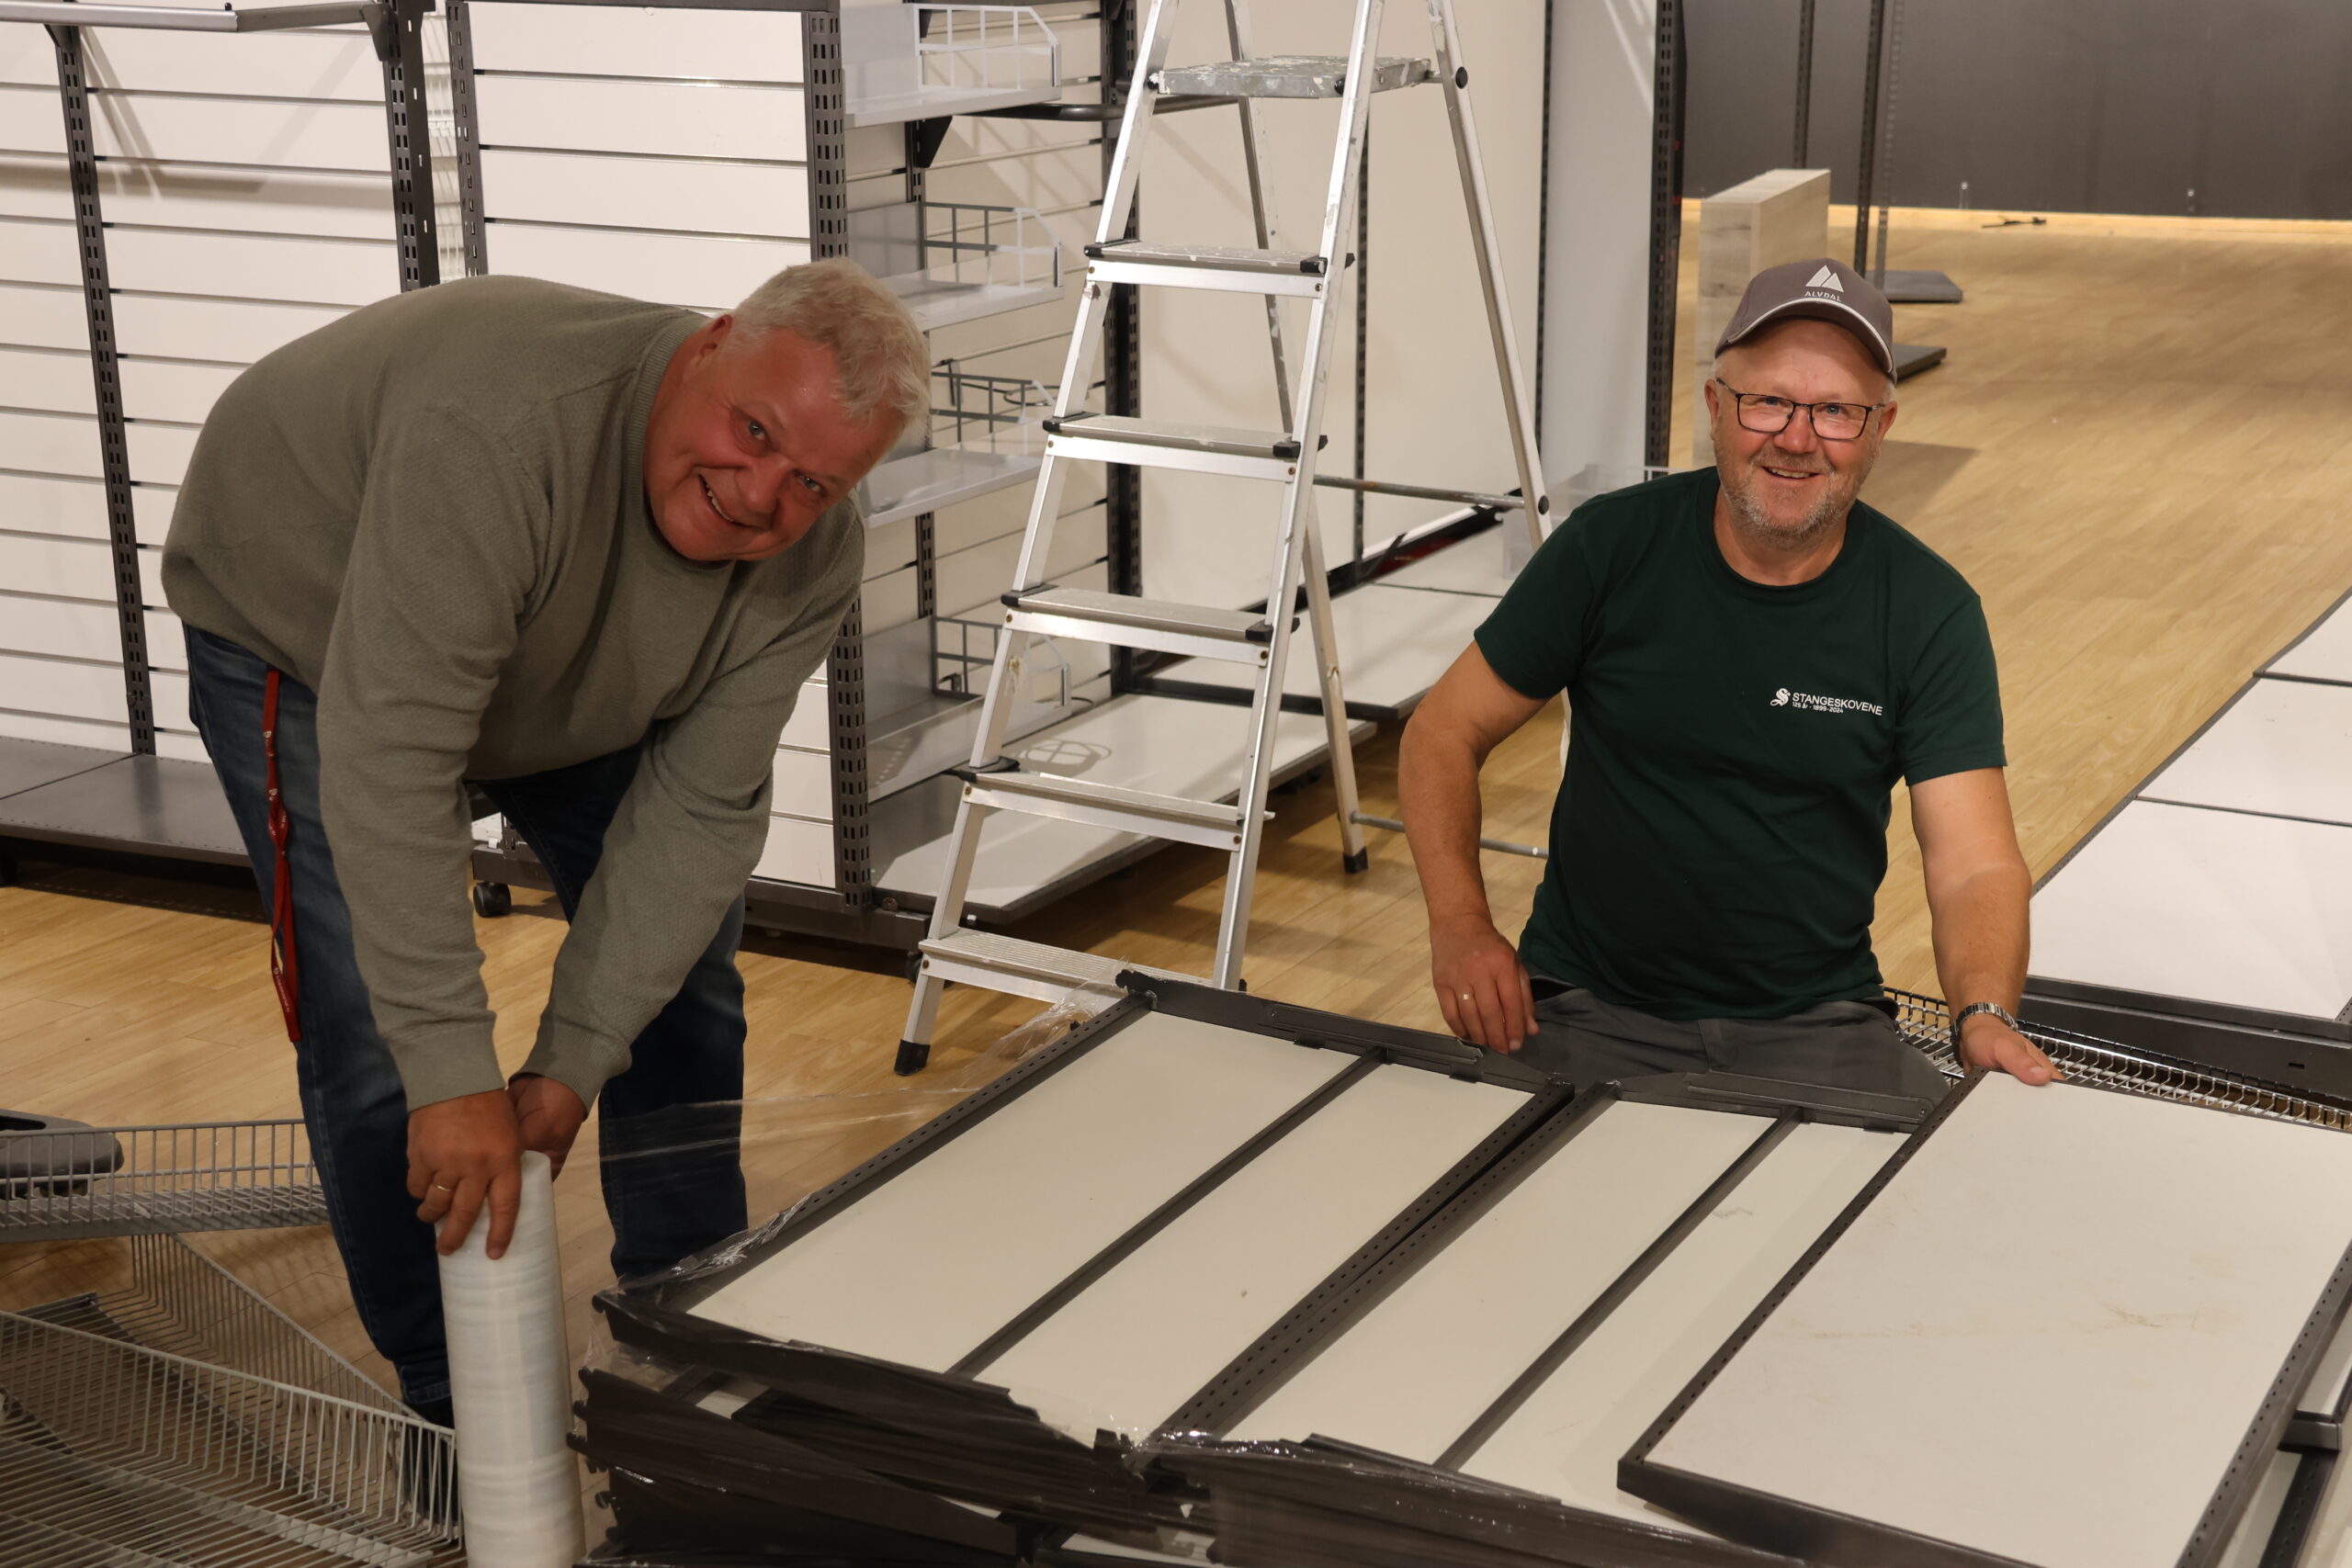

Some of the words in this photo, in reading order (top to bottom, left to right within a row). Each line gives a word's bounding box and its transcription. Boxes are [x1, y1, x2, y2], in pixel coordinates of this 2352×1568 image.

[1804, 290, 1842, 302] ALVDAL
[1792, 692, 1883, 716] STANGESKOVENE
[1813, 705, 1844, 714] 1899-2024
